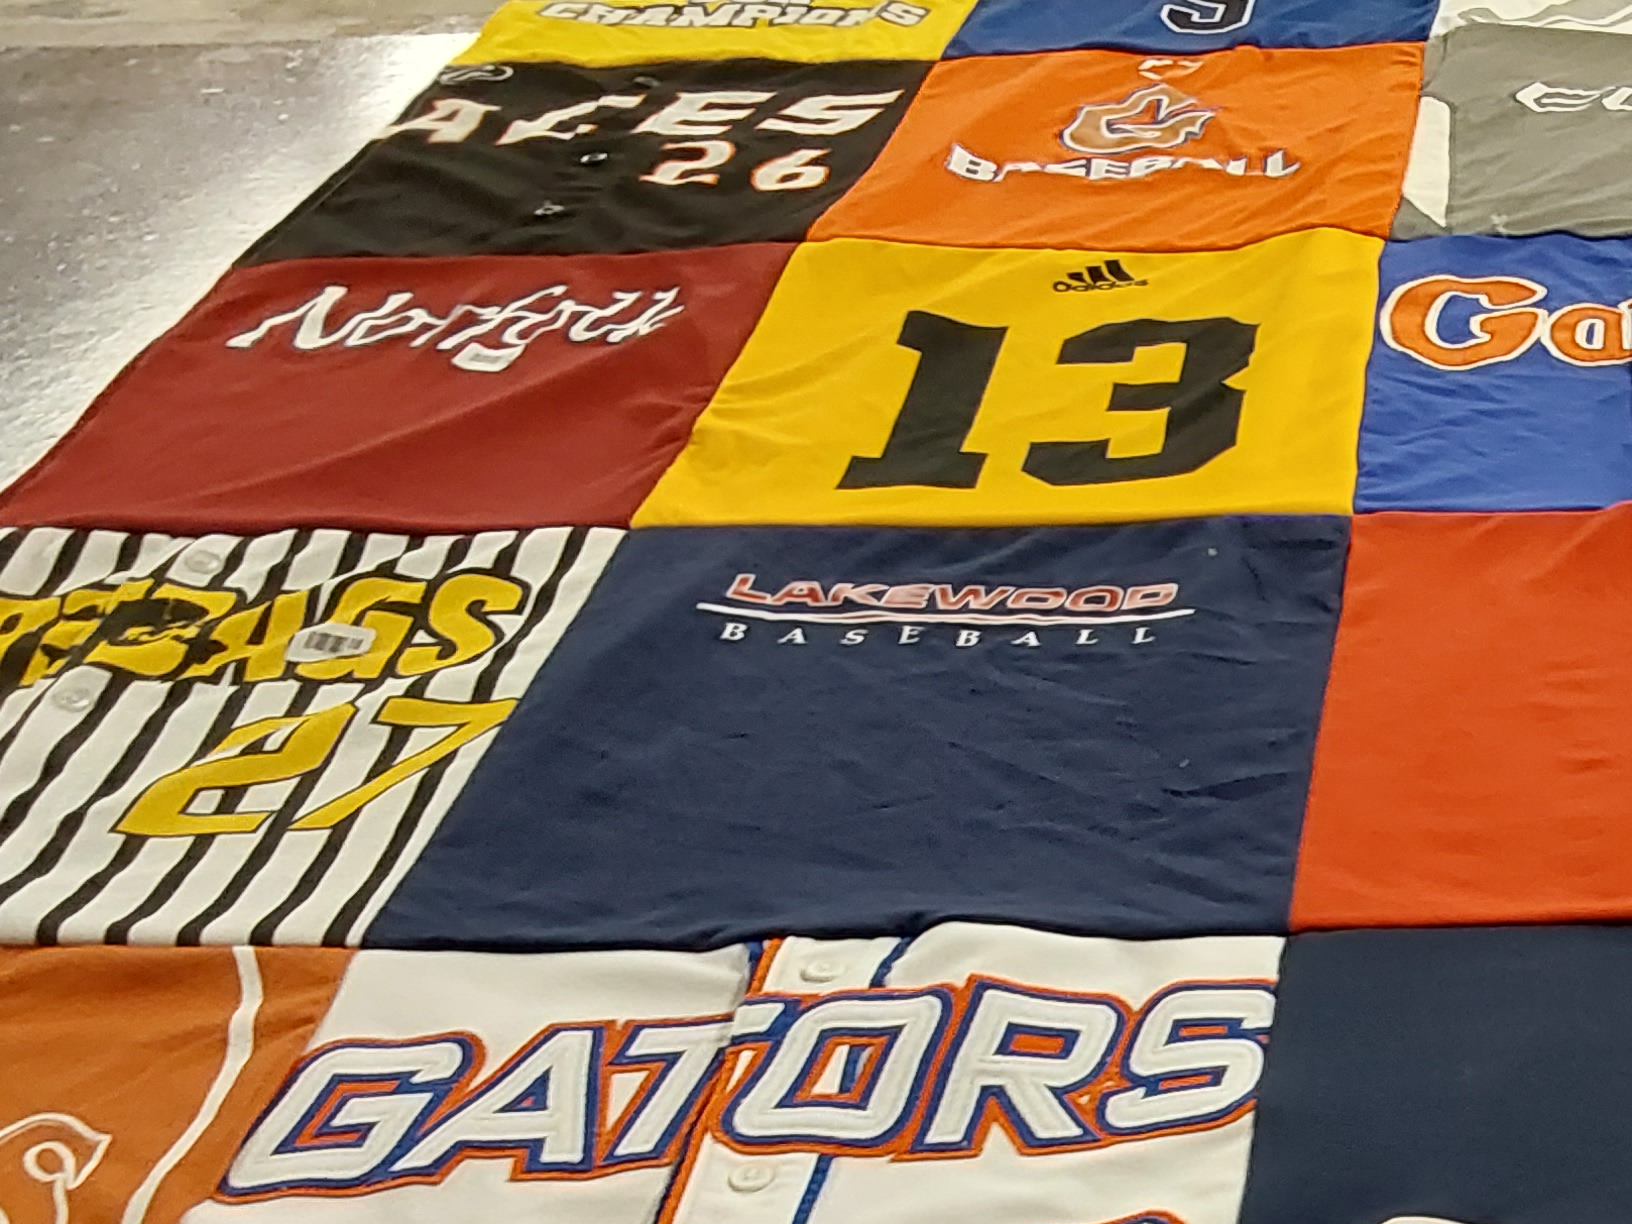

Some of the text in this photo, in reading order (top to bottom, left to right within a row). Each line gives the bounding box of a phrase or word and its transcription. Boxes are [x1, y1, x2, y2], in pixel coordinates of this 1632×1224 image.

[638, 140, 831, 192] 26
[226, 285, 685, 372] Norfolk
[834, 309, 1262, 491] 13
[719, 622, 1157, 647] BASEBALL
[725, 573, 1179, 611] LAKEWOOD
[108, 694, 520, 838] 27
[211, 975, 1279, 1206] GATORS
